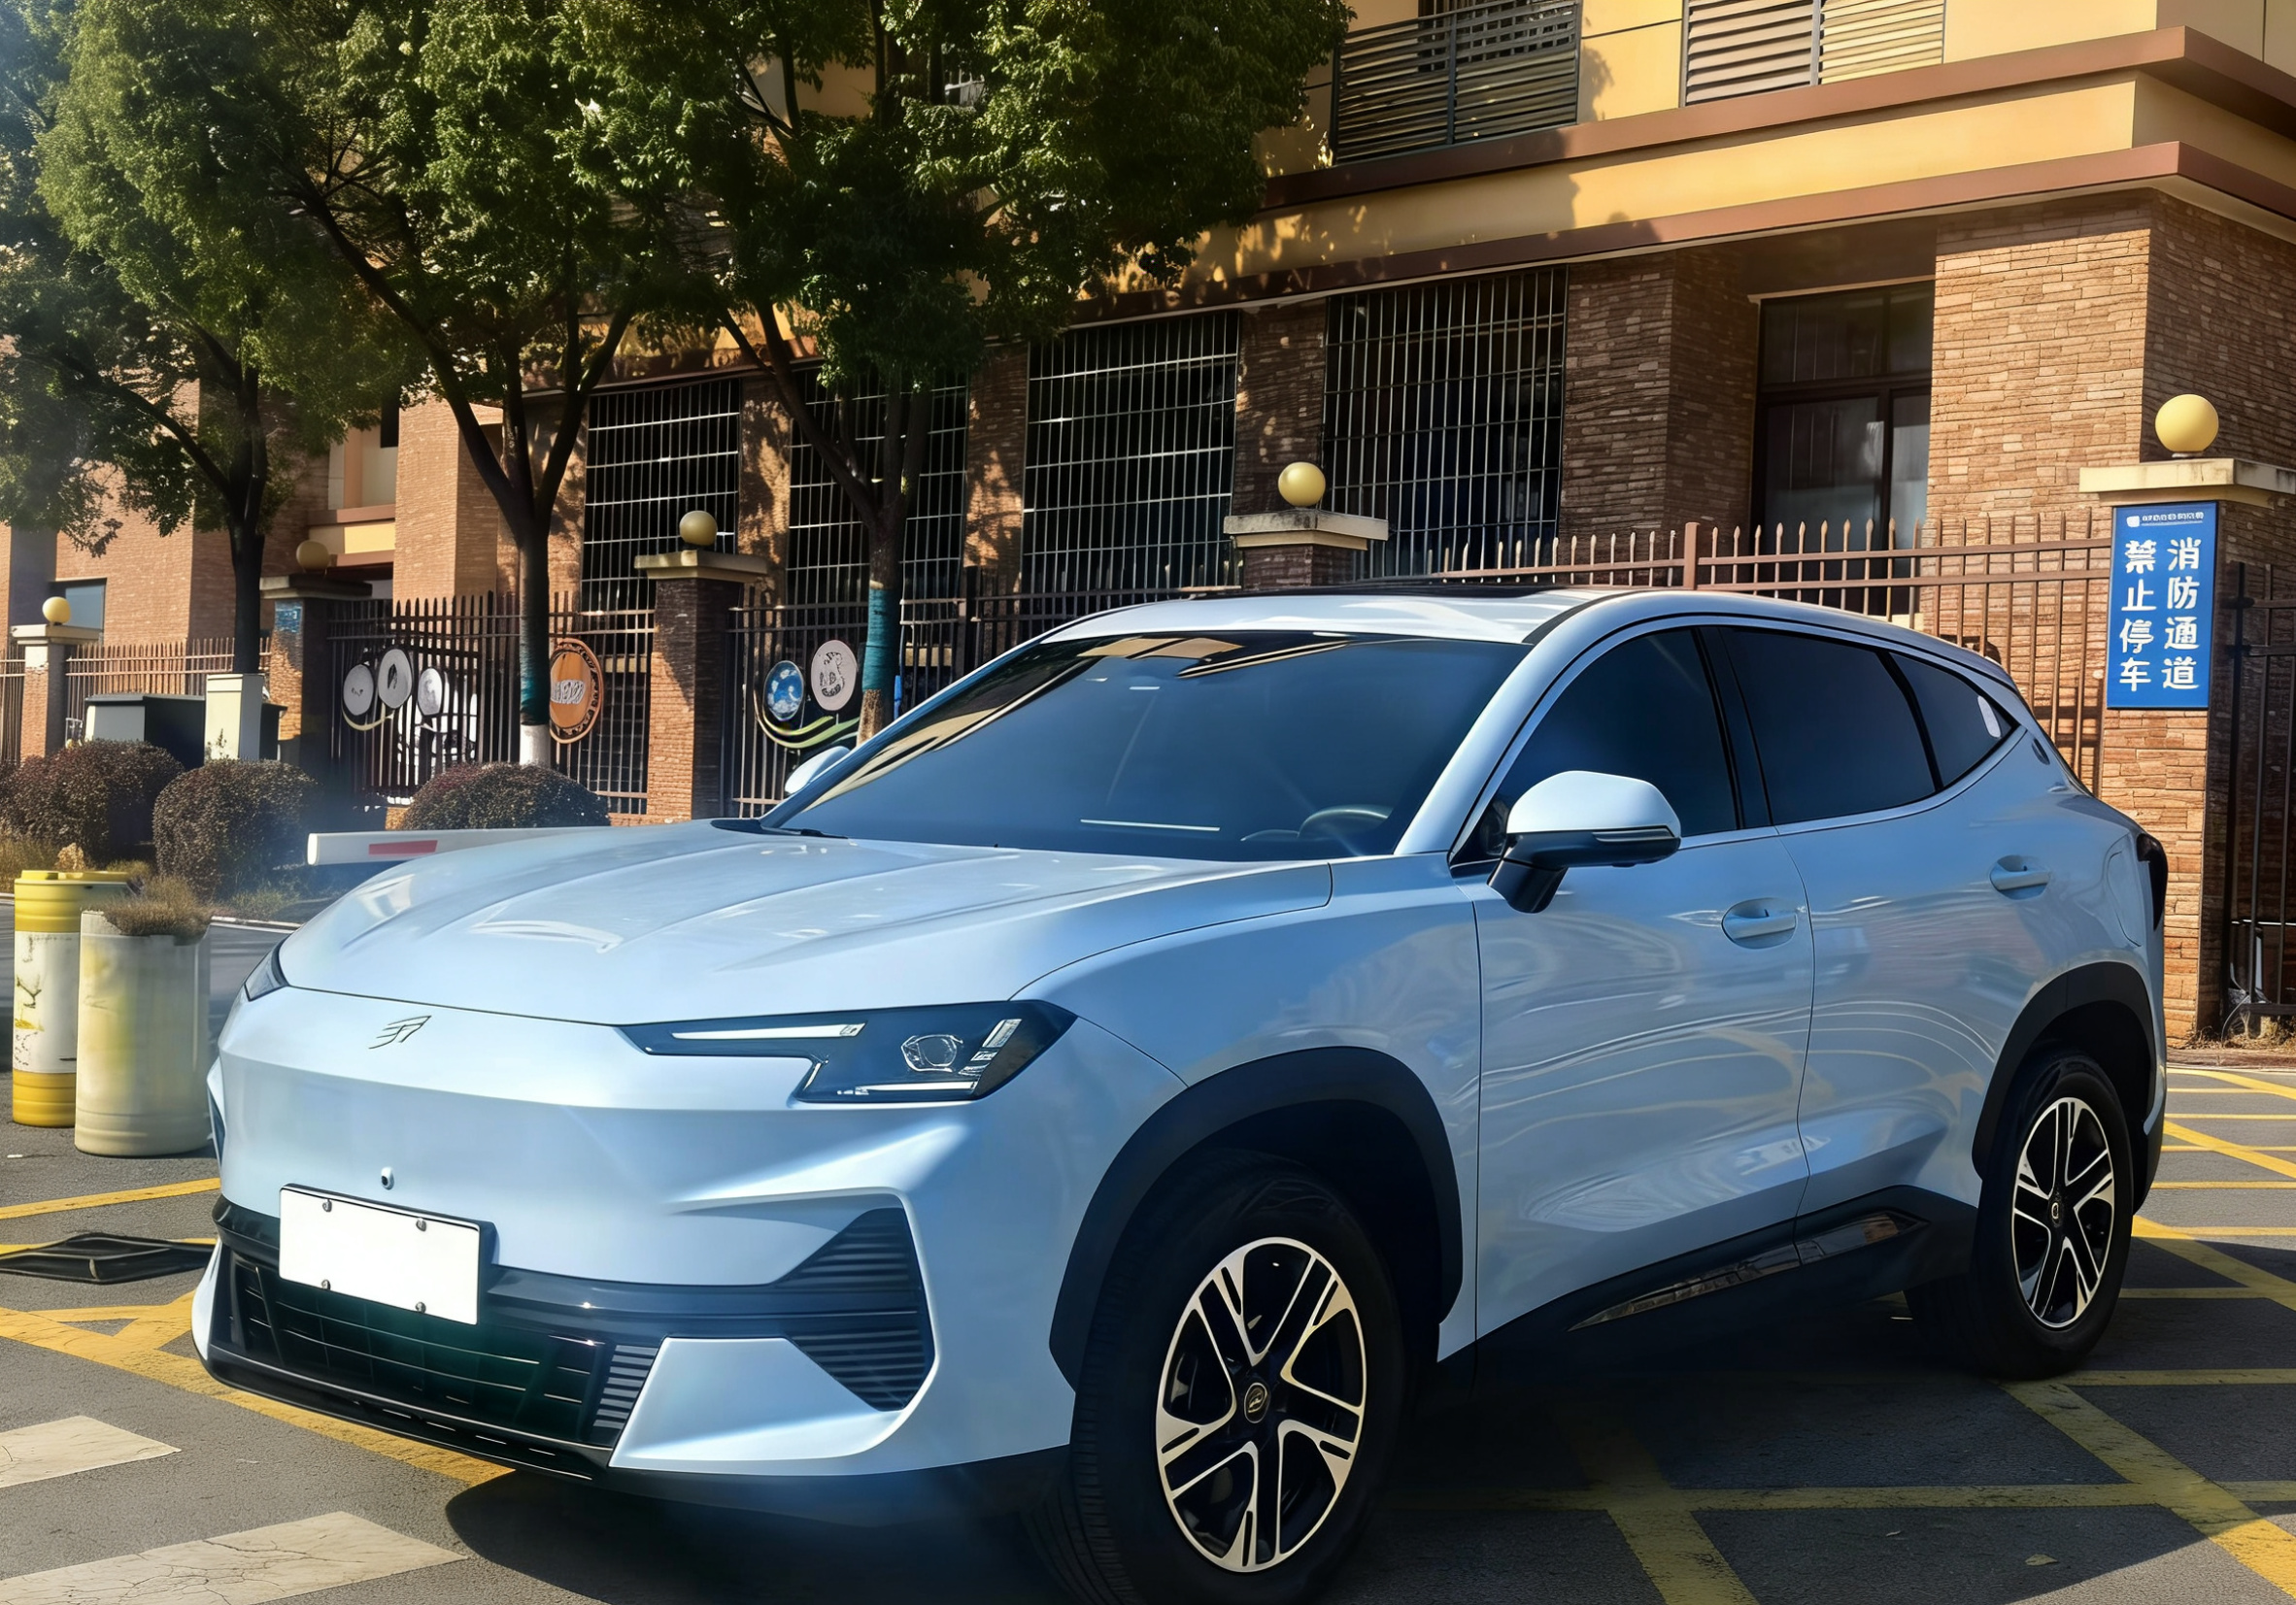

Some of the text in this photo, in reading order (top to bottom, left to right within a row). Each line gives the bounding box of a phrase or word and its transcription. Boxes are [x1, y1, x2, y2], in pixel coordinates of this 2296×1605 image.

[2119, 539, 2157, 692] 禁止停车
[2161, 537, 2202, 689] 消防通道
